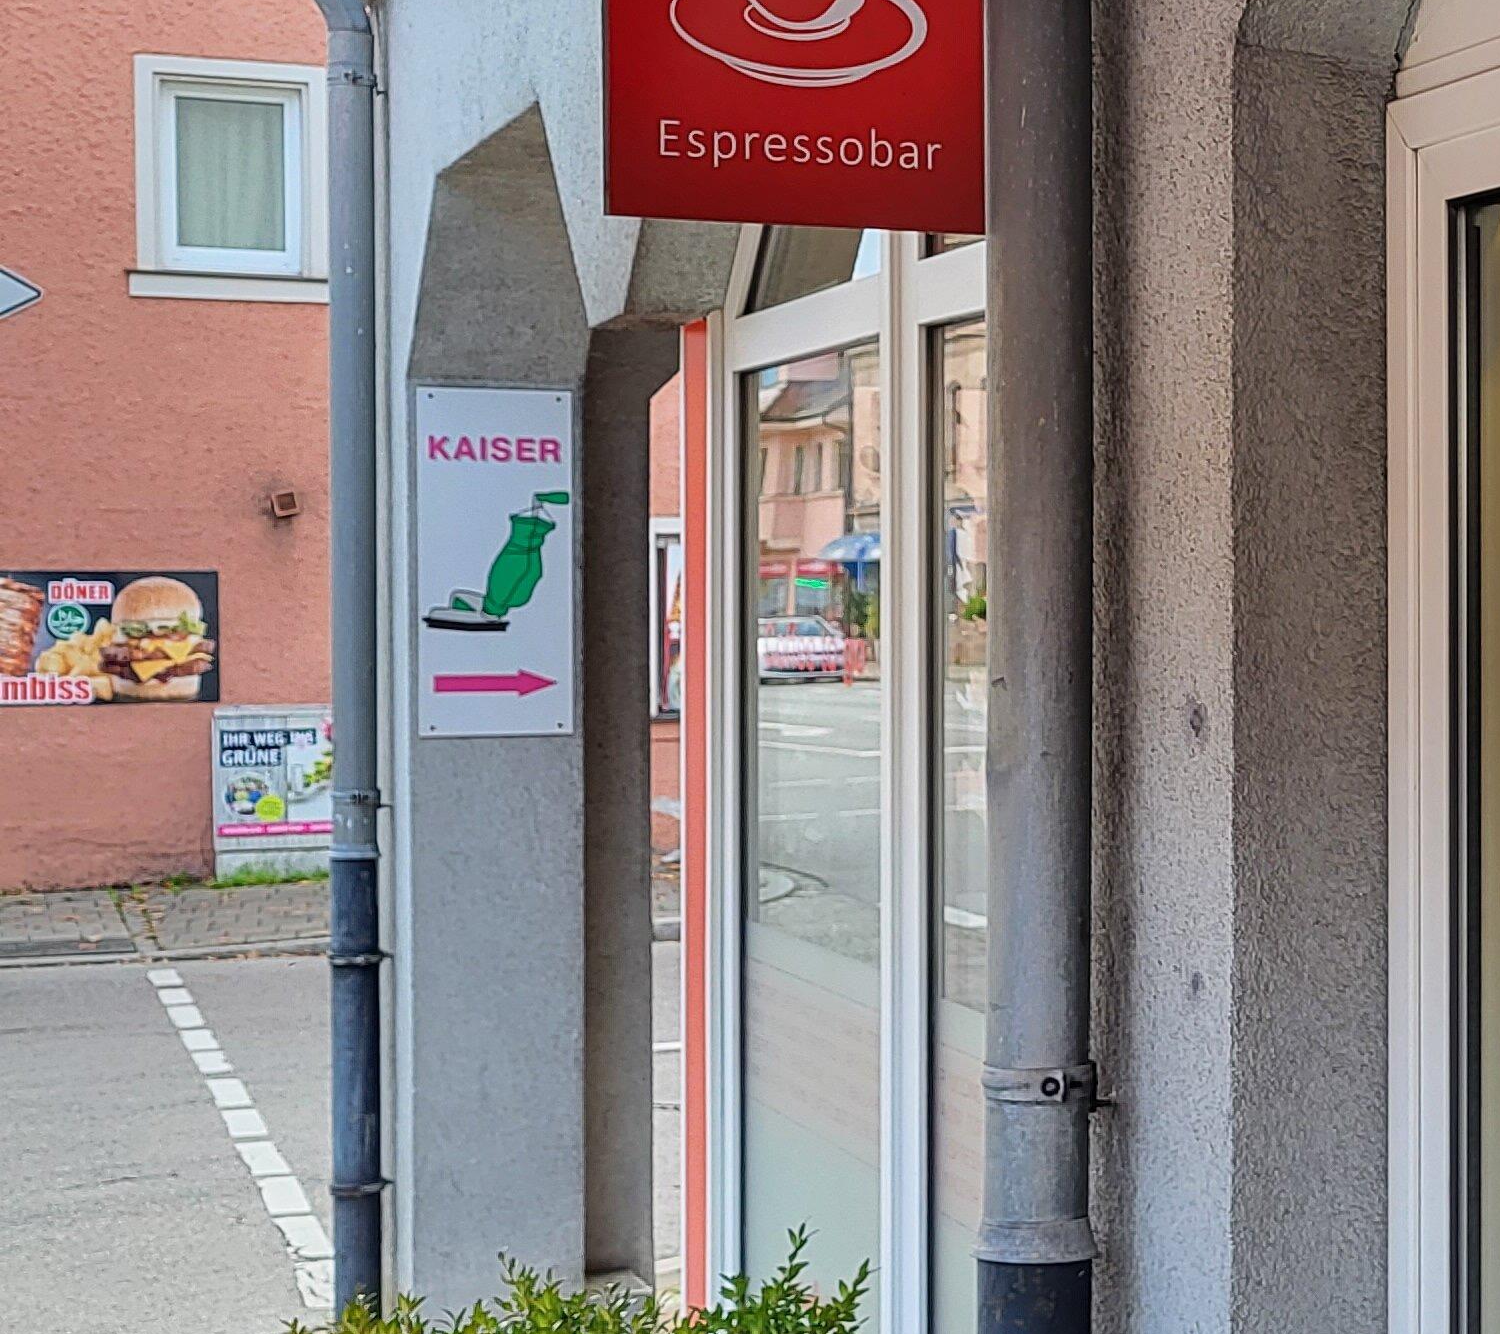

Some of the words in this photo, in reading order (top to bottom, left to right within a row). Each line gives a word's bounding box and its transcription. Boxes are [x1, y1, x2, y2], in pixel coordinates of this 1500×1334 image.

[658, 119, 942, 170] Espressobar
[427, 435, 562, 464] KAISER
[51, 583, 109, 599] DÖNER
[223, 732, 249, 747] IHR
[222, 746, 279, 765] GRÜNE
